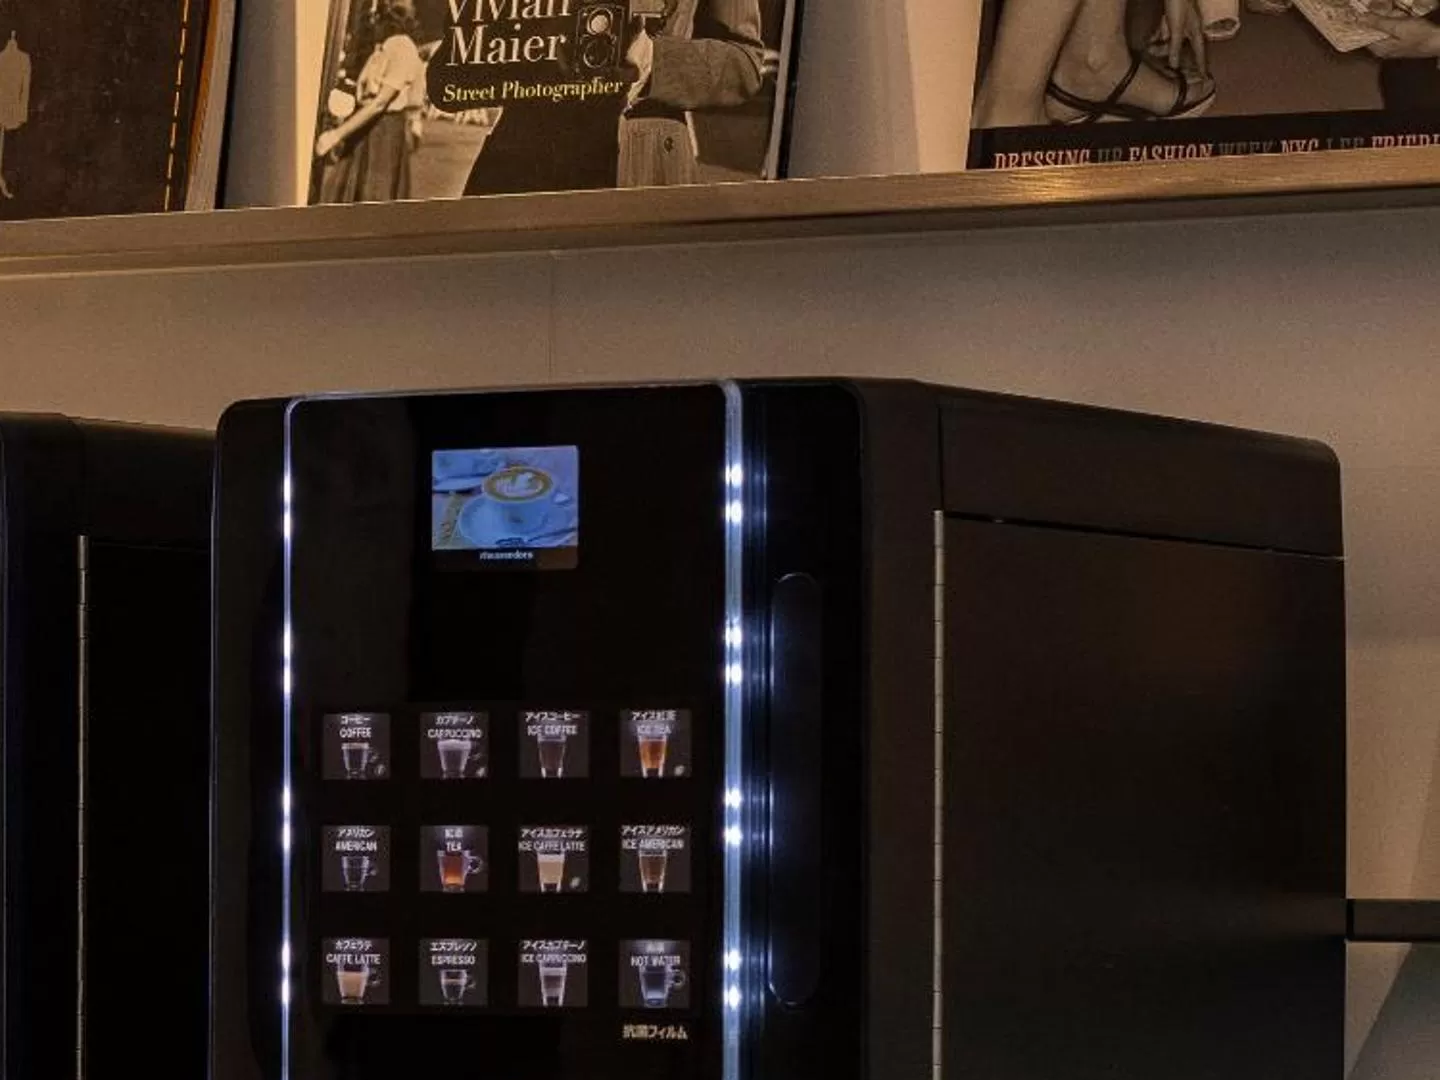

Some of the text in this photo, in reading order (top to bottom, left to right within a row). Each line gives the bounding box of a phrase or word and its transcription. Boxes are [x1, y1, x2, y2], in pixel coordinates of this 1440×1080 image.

[445, 22, 566, 66] Maier
[442, 76, 624, 103] Street Photographer
[1129, 143, 1213, 161] FASHION
[339, 727, 372, 738] COFFEE
[355, 954, 381, 965] LATTE
